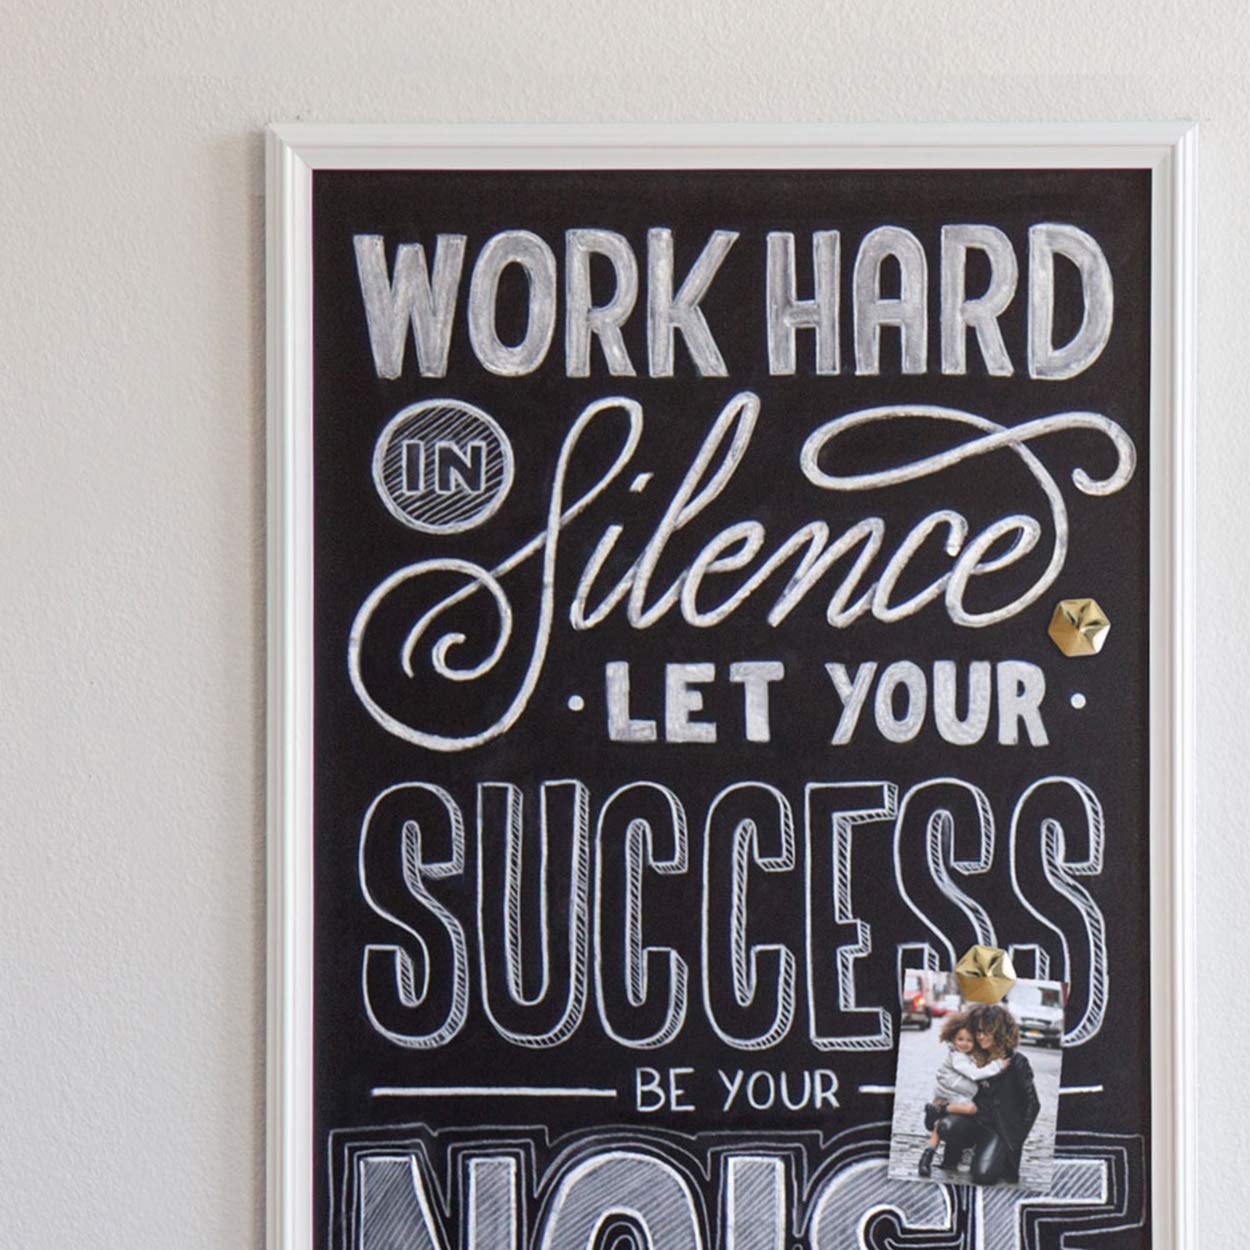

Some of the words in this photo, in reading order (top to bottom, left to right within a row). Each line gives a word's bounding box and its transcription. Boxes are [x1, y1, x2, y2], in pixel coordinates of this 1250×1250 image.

[352, 227, 740, 379] WORK
[766, 222, 1114, 380] HARD
[402, 440, 487, 495] IN
[347, 391, 1138, 752] Silence
[604, 660, 786, 744] LET
[824, 660, 1050, 746] YOUR
[359, 775, 1109, 1050] SUCCESS
[636, 1067, 695, 1113] BE
[718, 1067, 841, 1113] YOUR
